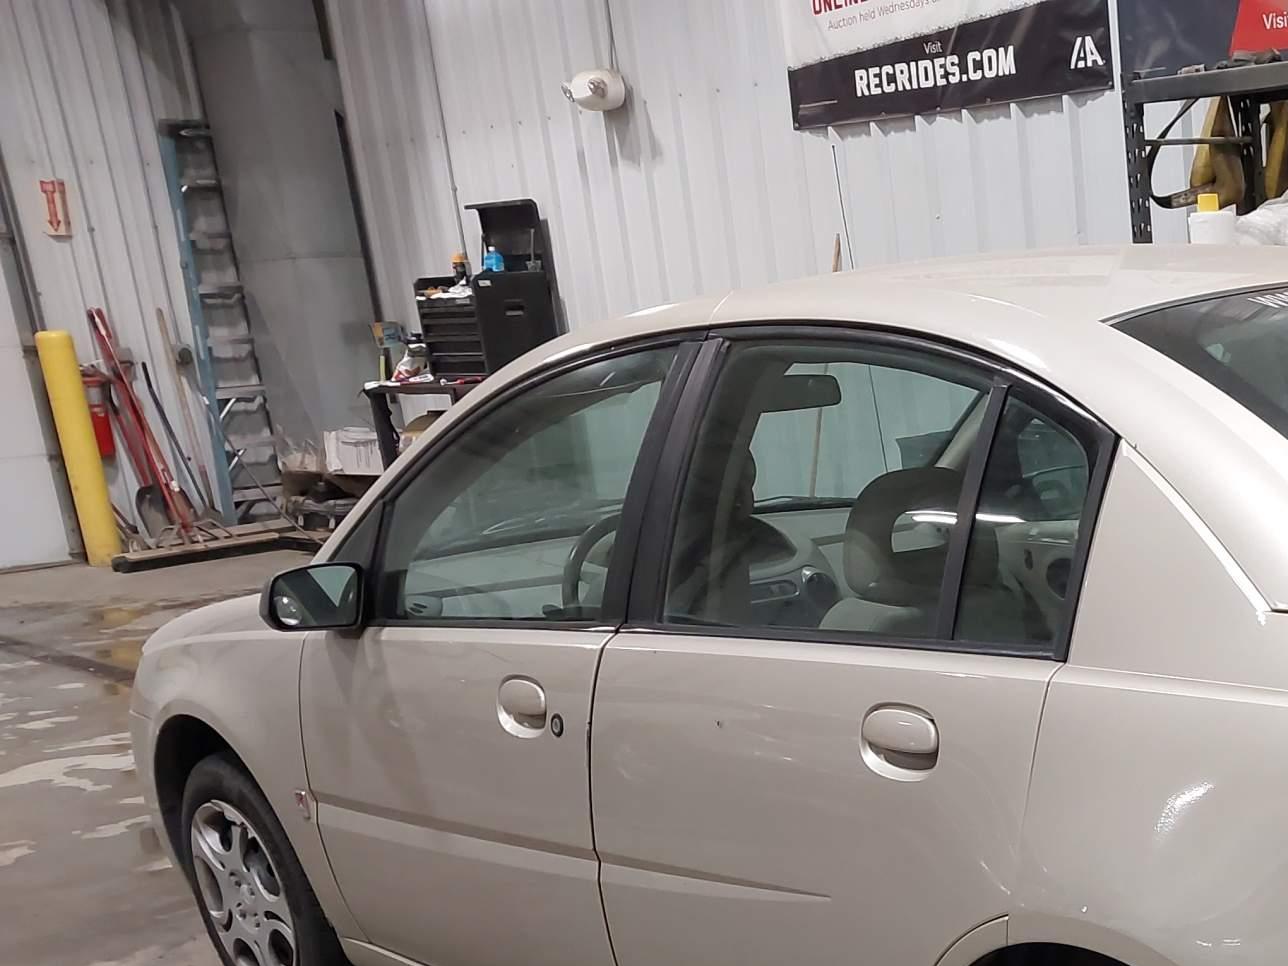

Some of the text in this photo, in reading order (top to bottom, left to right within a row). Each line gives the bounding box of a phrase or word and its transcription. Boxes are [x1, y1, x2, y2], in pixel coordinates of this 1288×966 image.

[827, 14, 857, 30] Auction
[859, 7, 876, 22] held
[923, 41, 943, 54] Visit
[854, 45, 1016, 97] RECRIDES.COM
